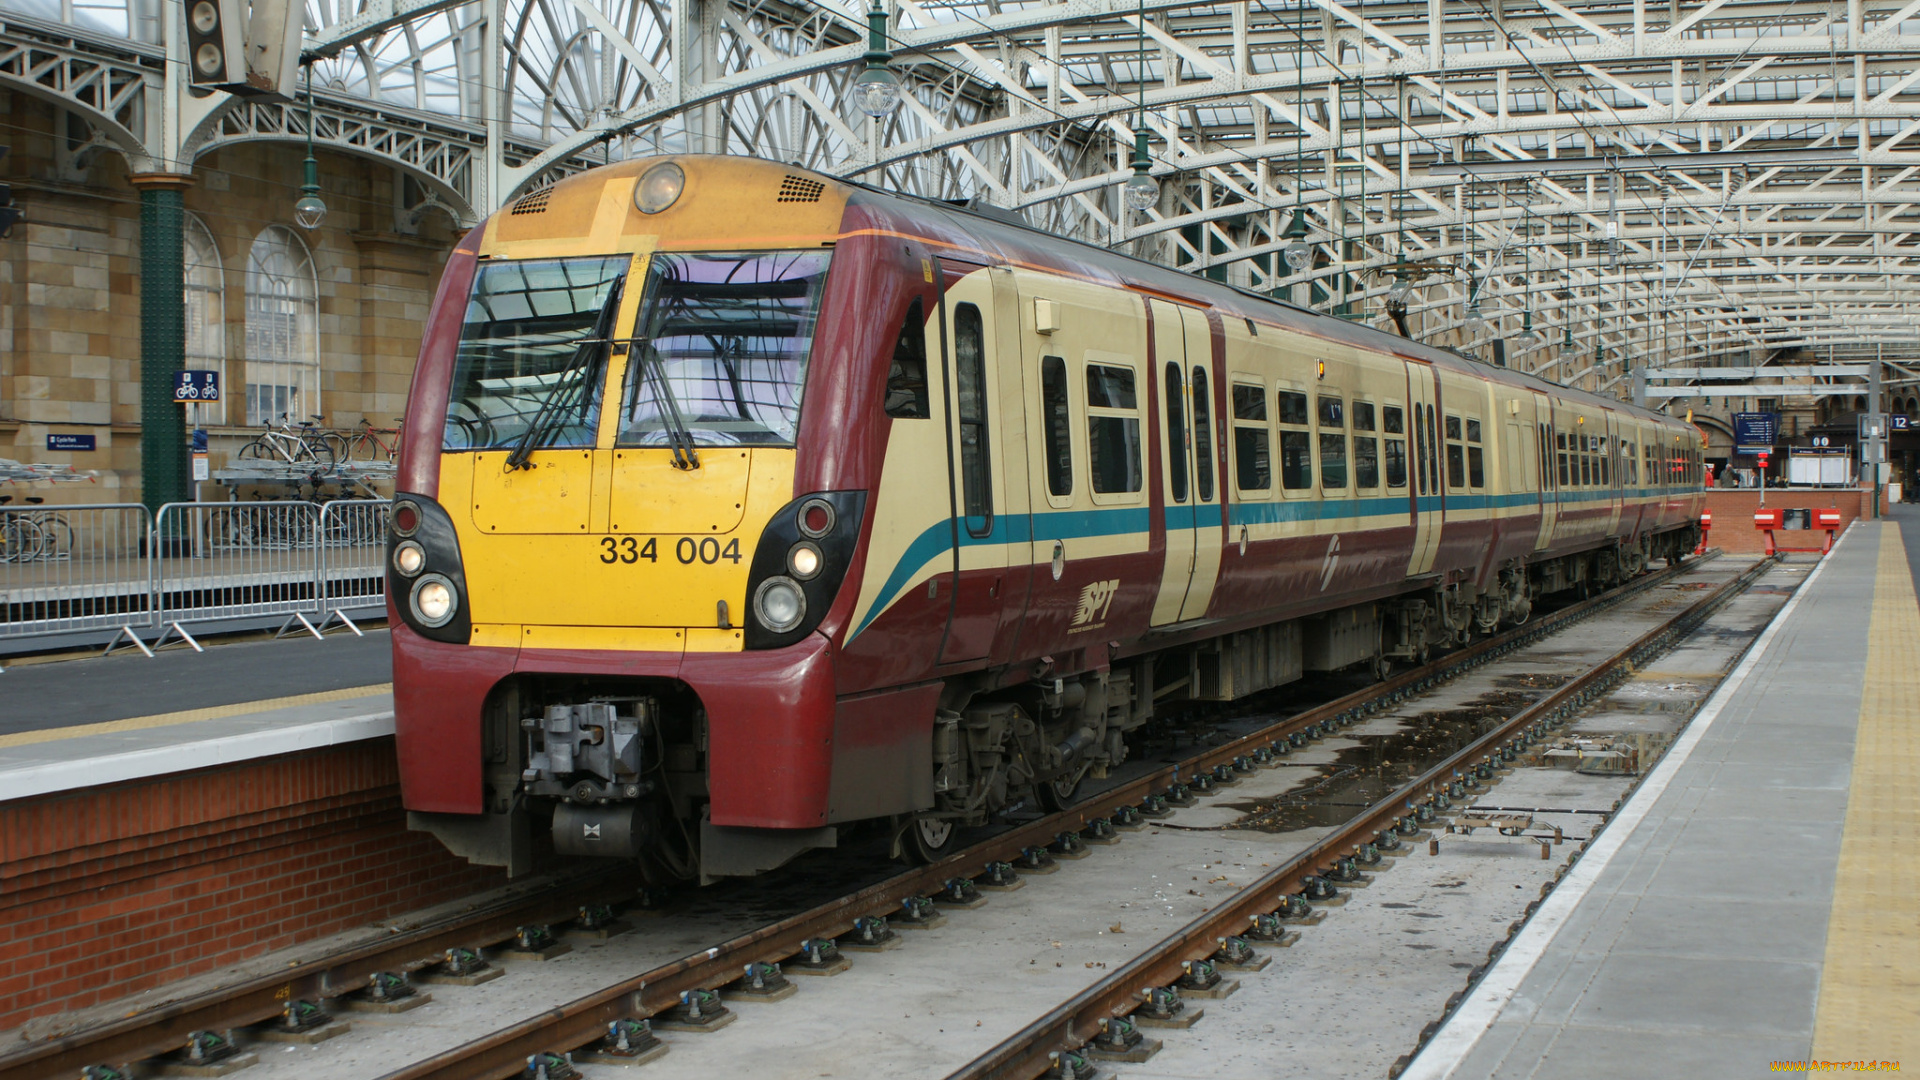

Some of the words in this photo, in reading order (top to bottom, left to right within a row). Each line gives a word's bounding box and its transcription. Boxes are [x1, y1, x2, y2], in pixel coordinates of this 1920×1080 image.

[1894, 417, 1907, 428] 12
[600, 537, 657, 564] 334
[676, 537, 742, 564] 004
[1070, 579, 1120, 626] SPT
